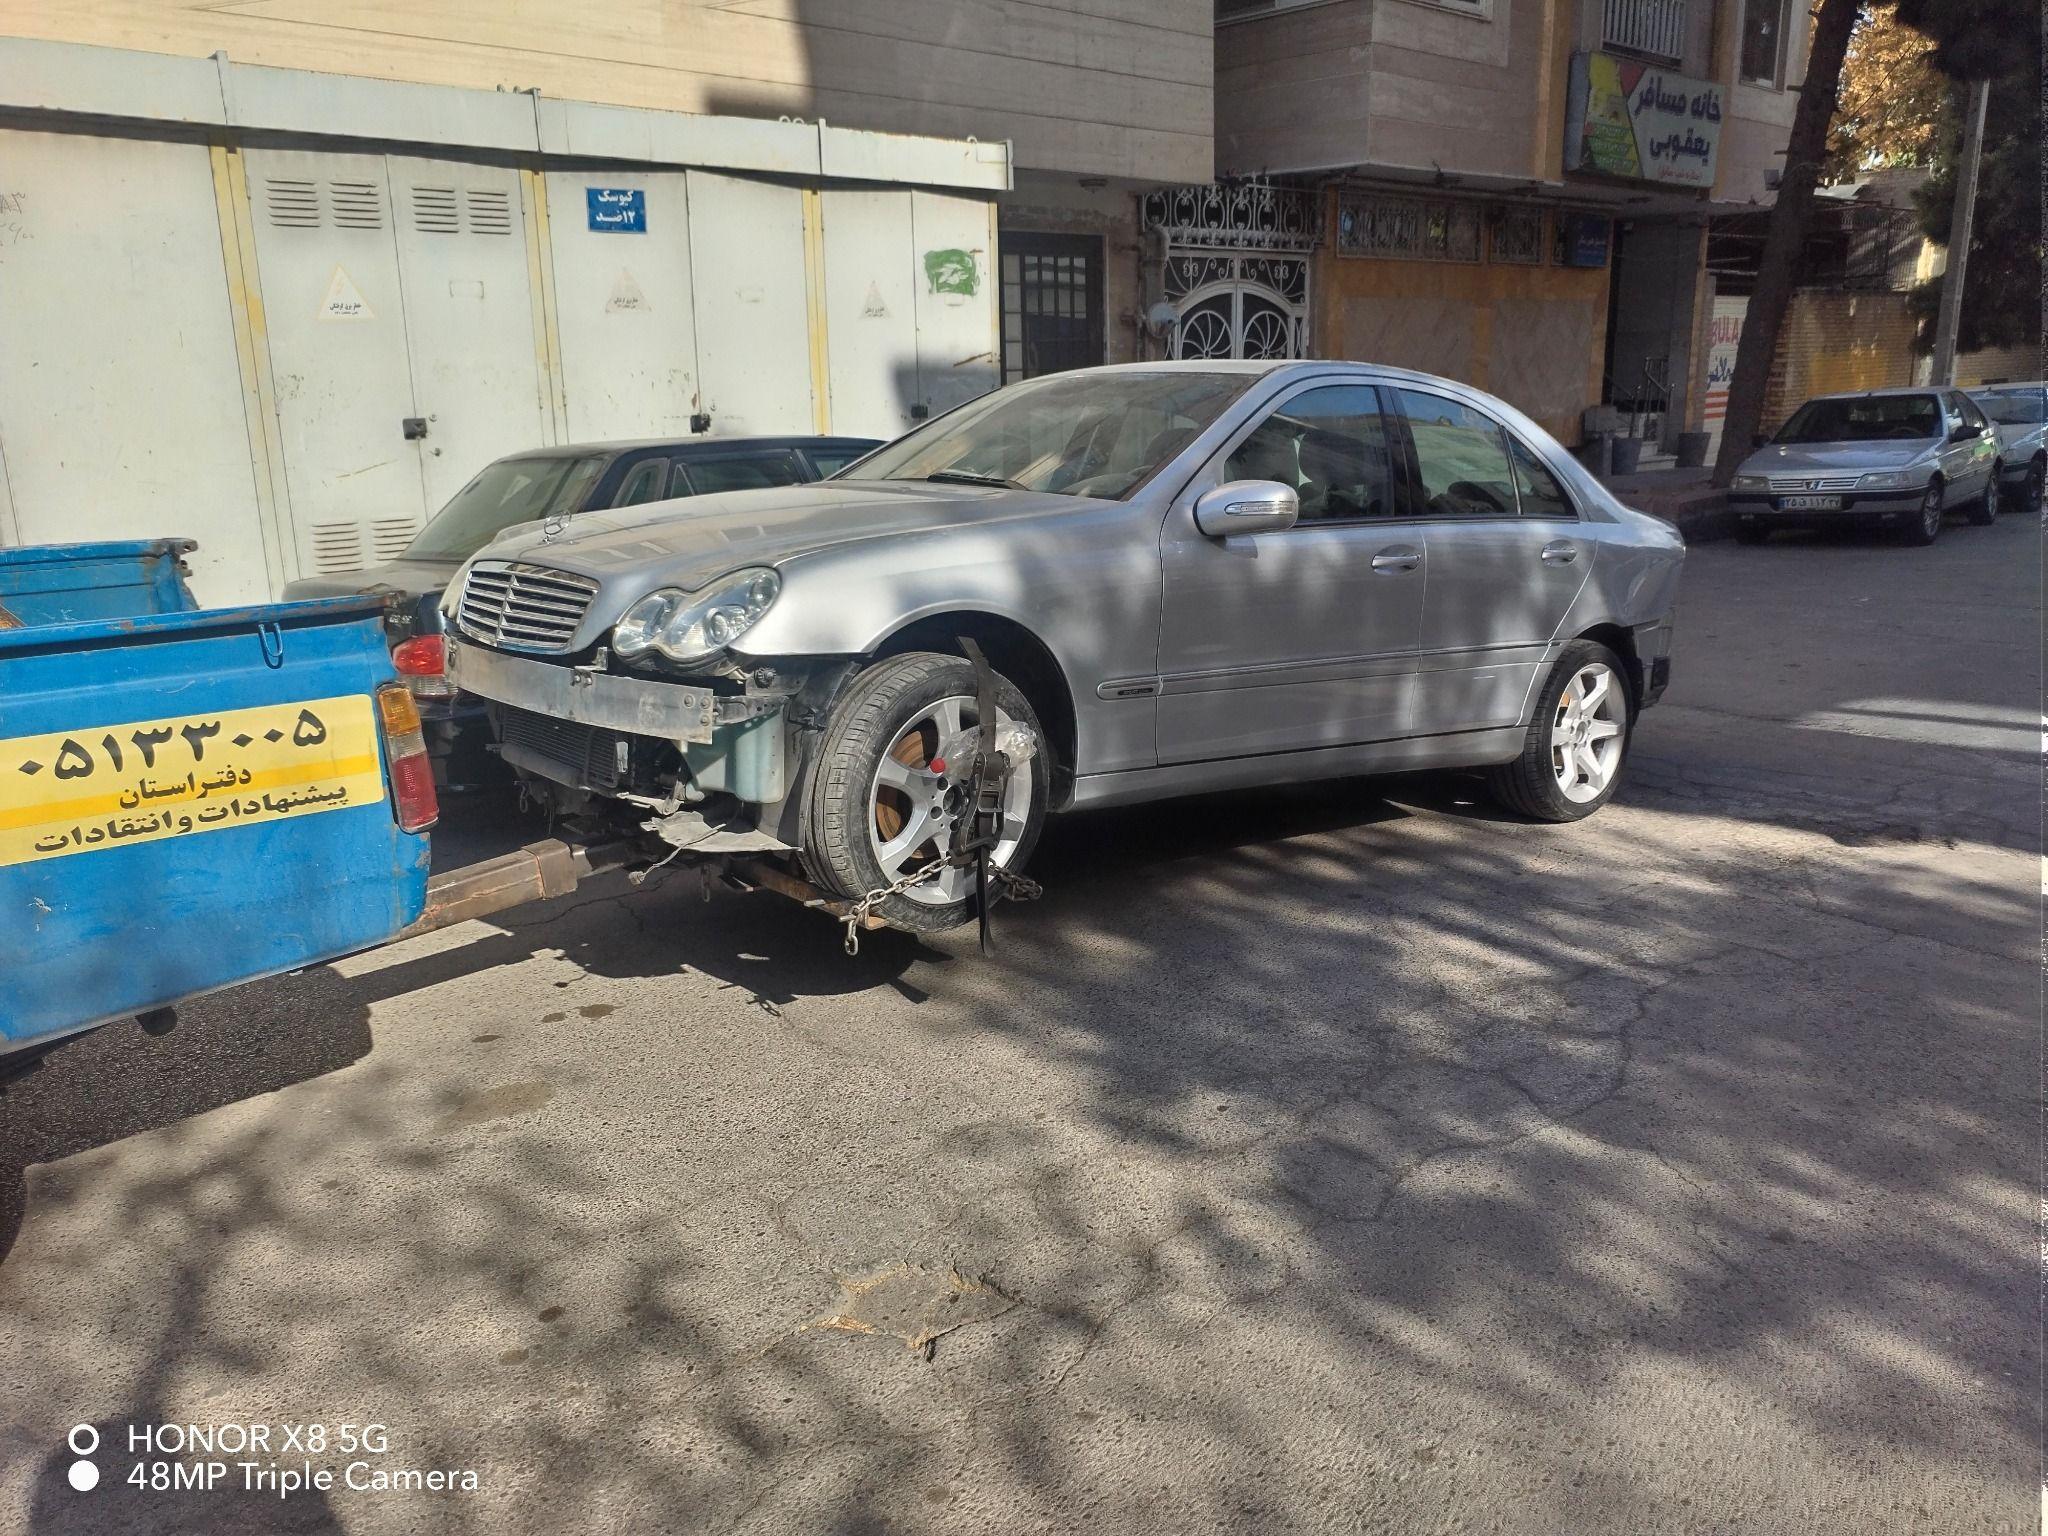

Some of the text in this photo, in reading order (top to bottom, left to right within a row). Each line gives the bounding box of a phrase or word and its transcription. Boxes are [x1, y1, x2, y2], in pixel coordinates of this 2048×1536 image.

[1634, 76, 1721, 122] خانه مسافر
[1649, 128, 1711, 166] یعقوبی
[597, 190, 634, 206] کیوسک
[17, 708, 327, 780] ۰۵۱۳۳۰۰۵
[197, 784, 347, 824] پیشنهادات
[34, 810, 173, 852] انتقادات
